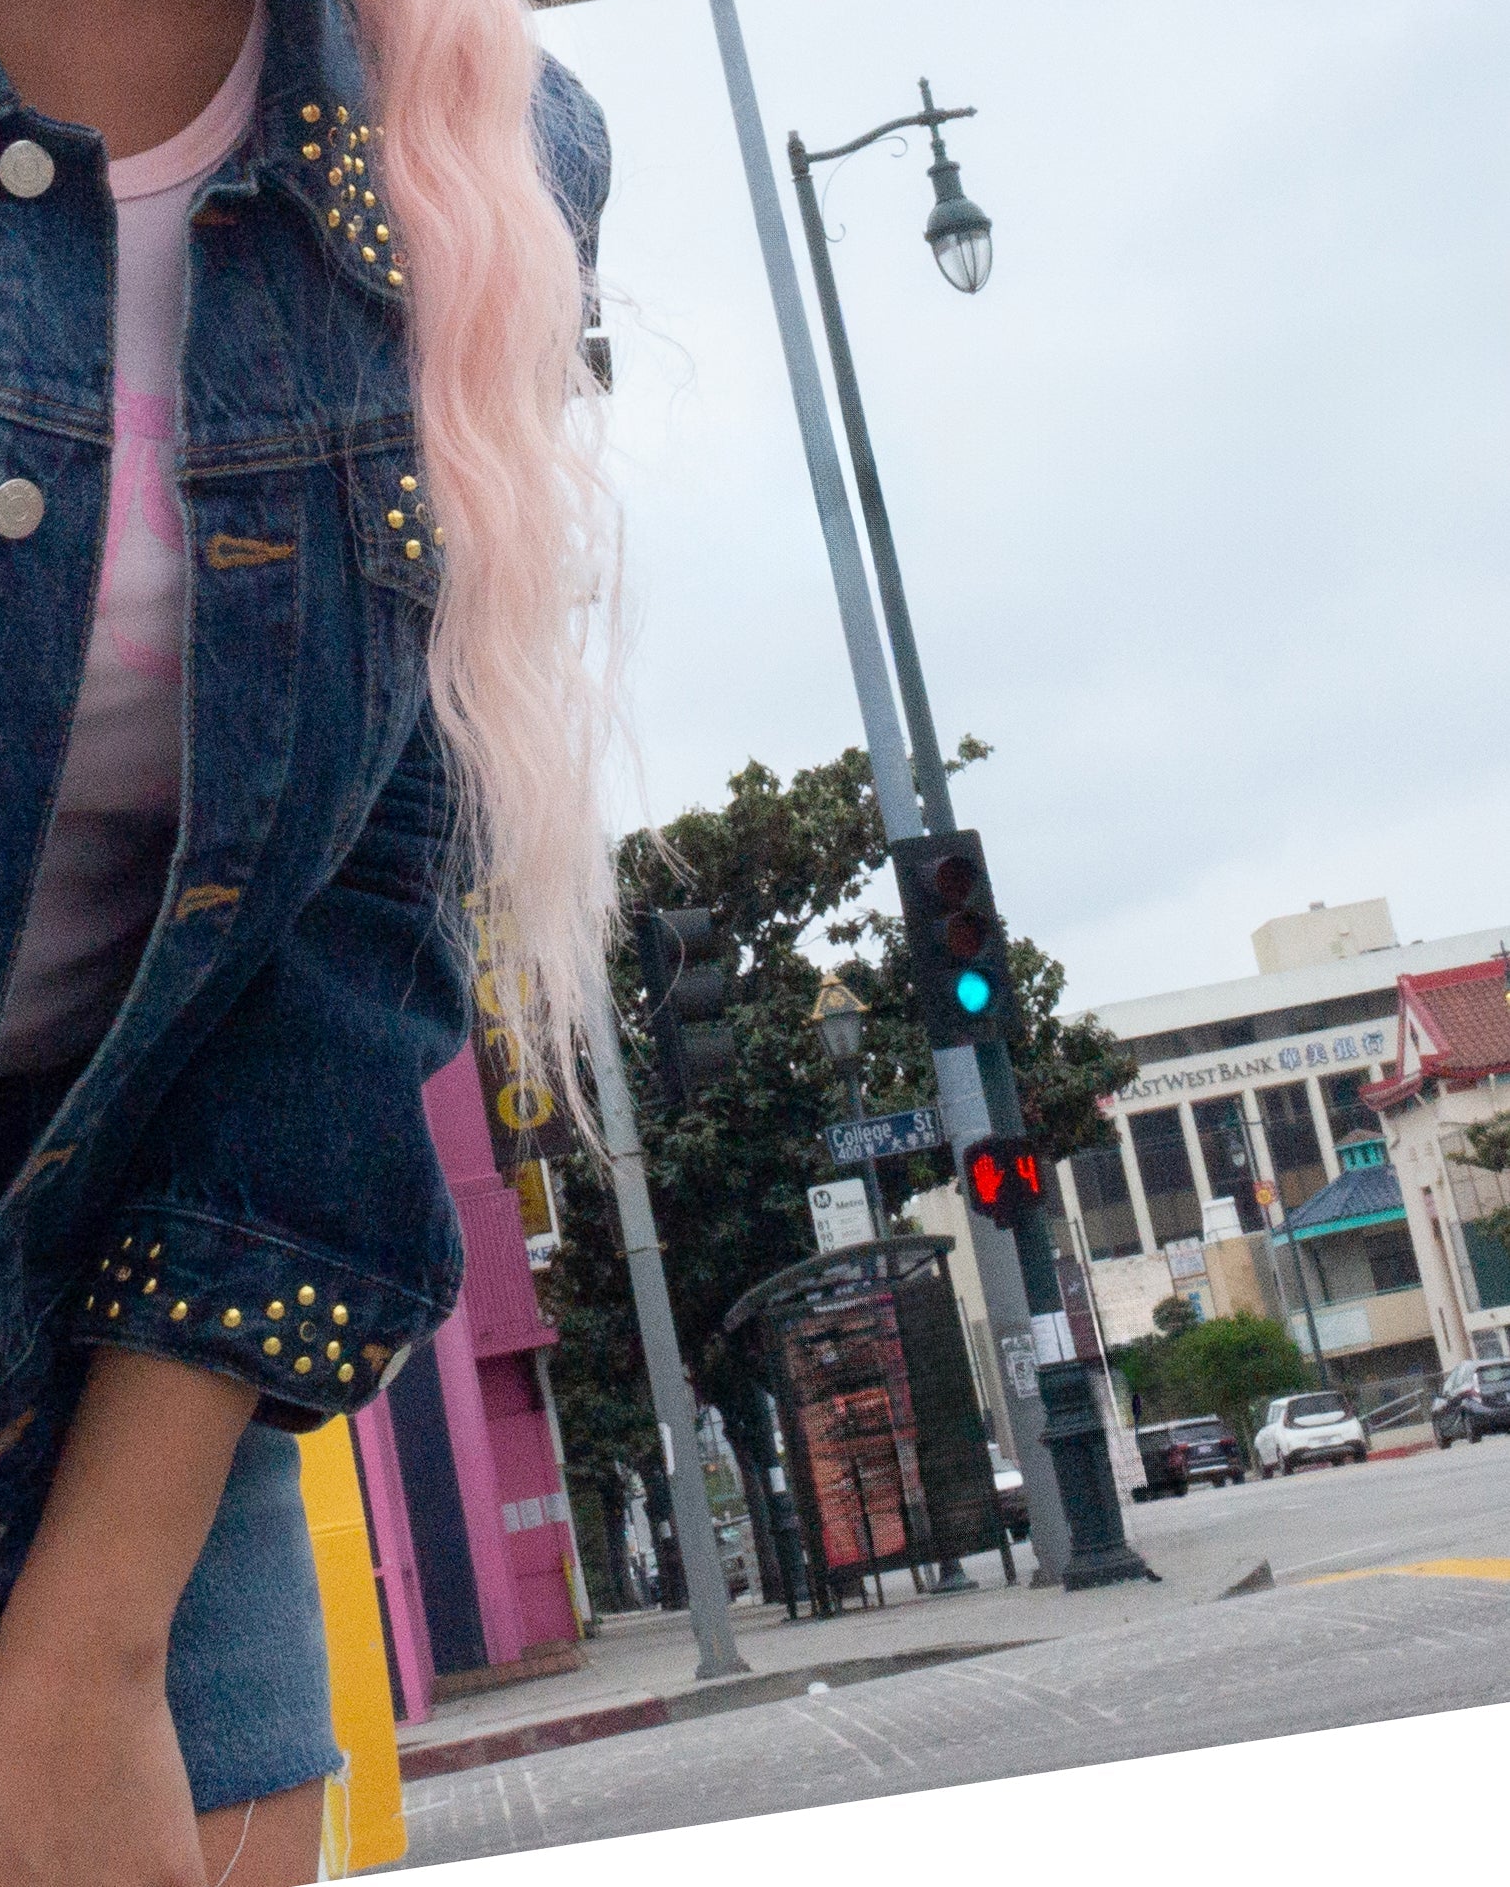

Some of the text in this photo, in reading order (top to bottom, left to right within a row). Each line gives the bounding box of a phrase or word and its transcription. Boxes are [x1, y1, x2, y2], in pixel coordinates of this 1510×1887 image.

[832, 1122, 892, 1148] College
[913, 1112, 934, 1132] St
[1016, 1154, 1040, 1194] 4
